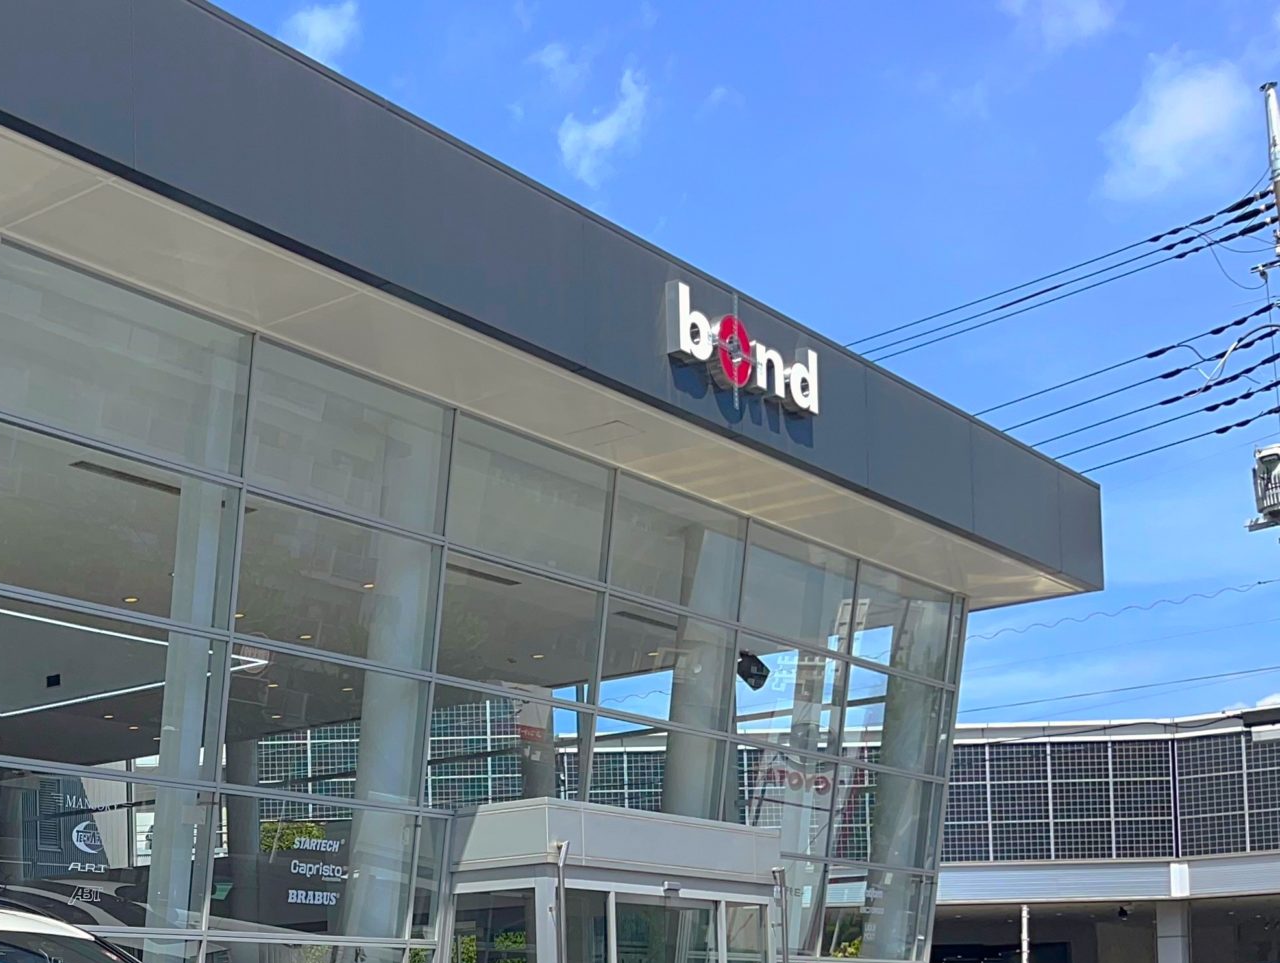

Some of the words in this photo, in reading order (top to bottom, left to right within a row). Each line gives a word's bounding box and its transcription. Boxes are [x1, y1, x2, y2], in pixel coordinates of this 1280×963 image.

[666, 279, 819, 416] bond
[65, 794, 118, 812] MANOR
[293, 837, 340, 852] STARTECH
[290, 860, 342, 878] Capristo
[67, 885, 103, 905] ABT
[287, 889, 337, 905] BRABUS
